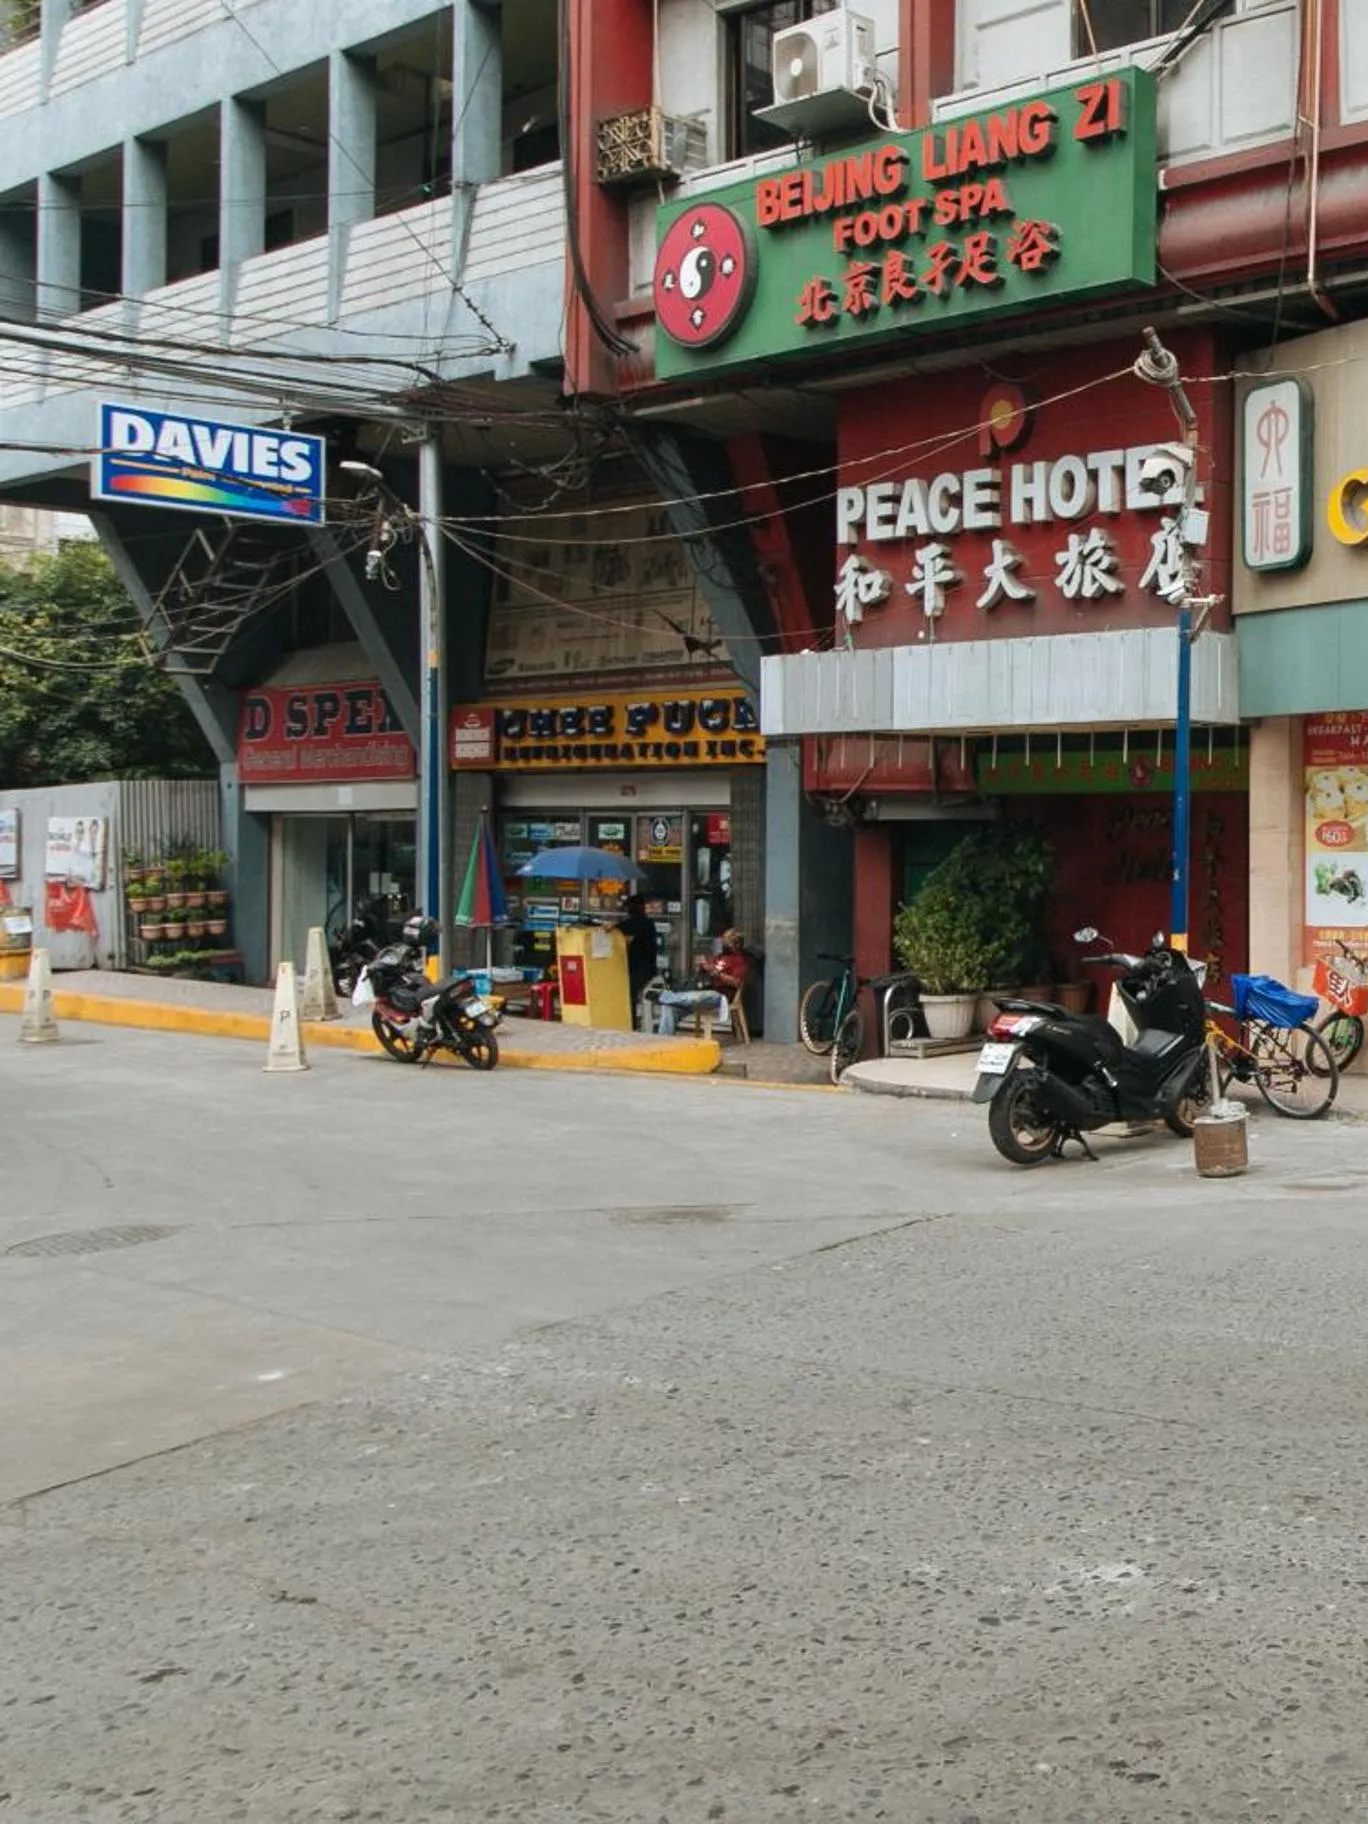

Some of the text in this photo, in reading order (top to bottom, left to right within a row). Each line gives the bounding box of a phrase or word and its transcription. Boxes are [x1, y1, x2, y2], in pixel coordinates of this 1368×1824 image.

[755, 79, 1126, 228] BEIJING LIANG ZI
[833, 180, 1013, 252] FOOT SPA
[110, 411, 313, 482] DAVIES
[836, 467, 1001, 545] PEACE
